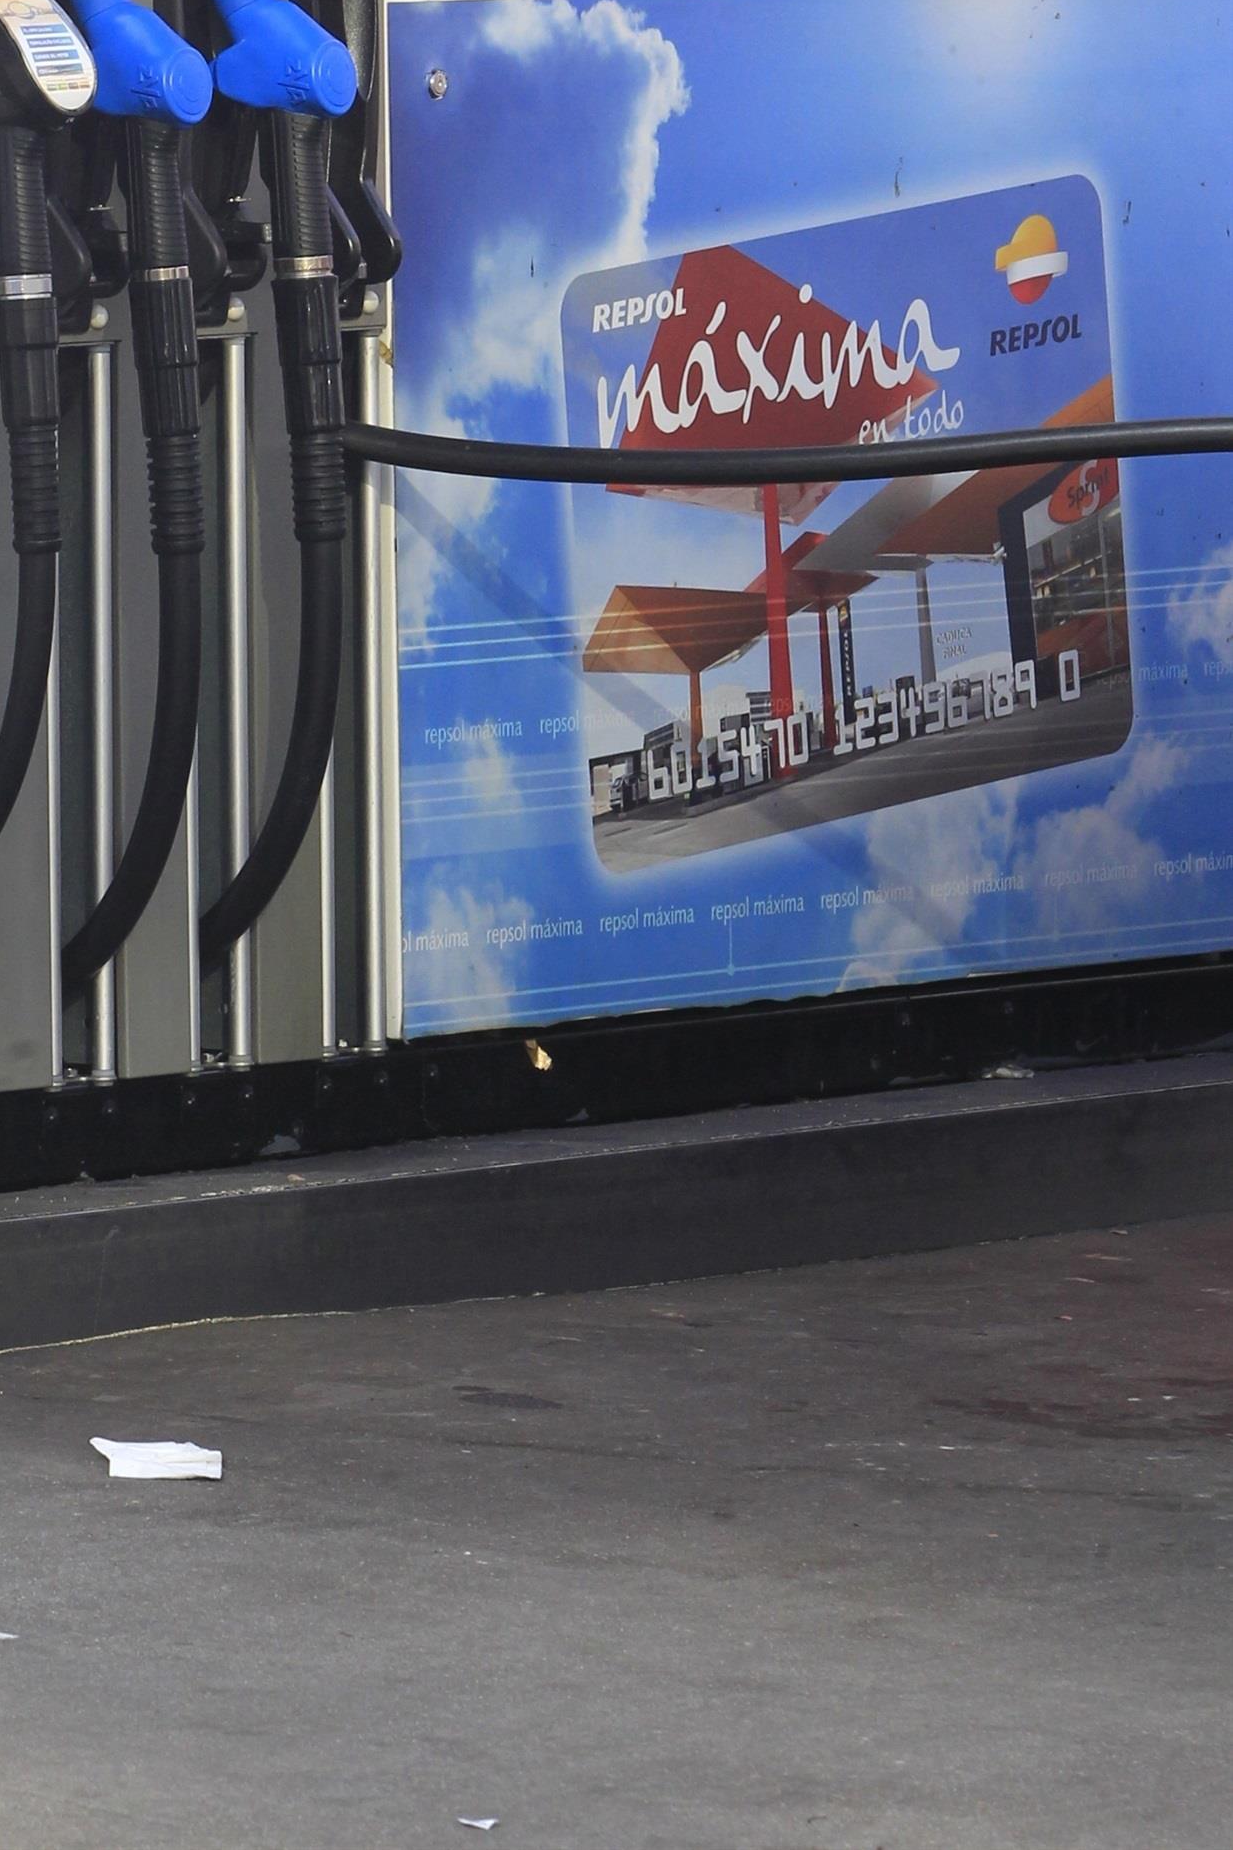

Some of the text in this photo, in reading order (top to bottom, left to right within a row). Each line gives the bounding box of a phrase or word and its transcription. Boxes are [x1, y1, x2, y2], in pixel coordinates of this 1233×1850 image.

[592, 287, 687, 334] REPSOL
[989, 314, 1082, 358] REPSOL
[596, 284, 962, 449] máxima
[903, 396, 965, 441] todo
[425, 723, 465, 748] repsol
[469, 718, 523, 740] máxima
[539, 710, 580, 736] repsol
[1139, 663, 1188, 682] máxima
[1204, 660, 1233, 683] rep
[415, 928, 469, 951] máxima
[486, 923, 527, 950] repsol
[530, 917, 583, 941] máxima
[600, 911, 639, 937] repsol
[643, 905, 695, 927] máxima
[711, 897, 750, 924] repsol
[754, 893, 805, 916] máxima
[821, 886, 860, 913] repsol
[973, 872, 1025, 895] máxima
[1154, 854, 1193, 880] repsol
